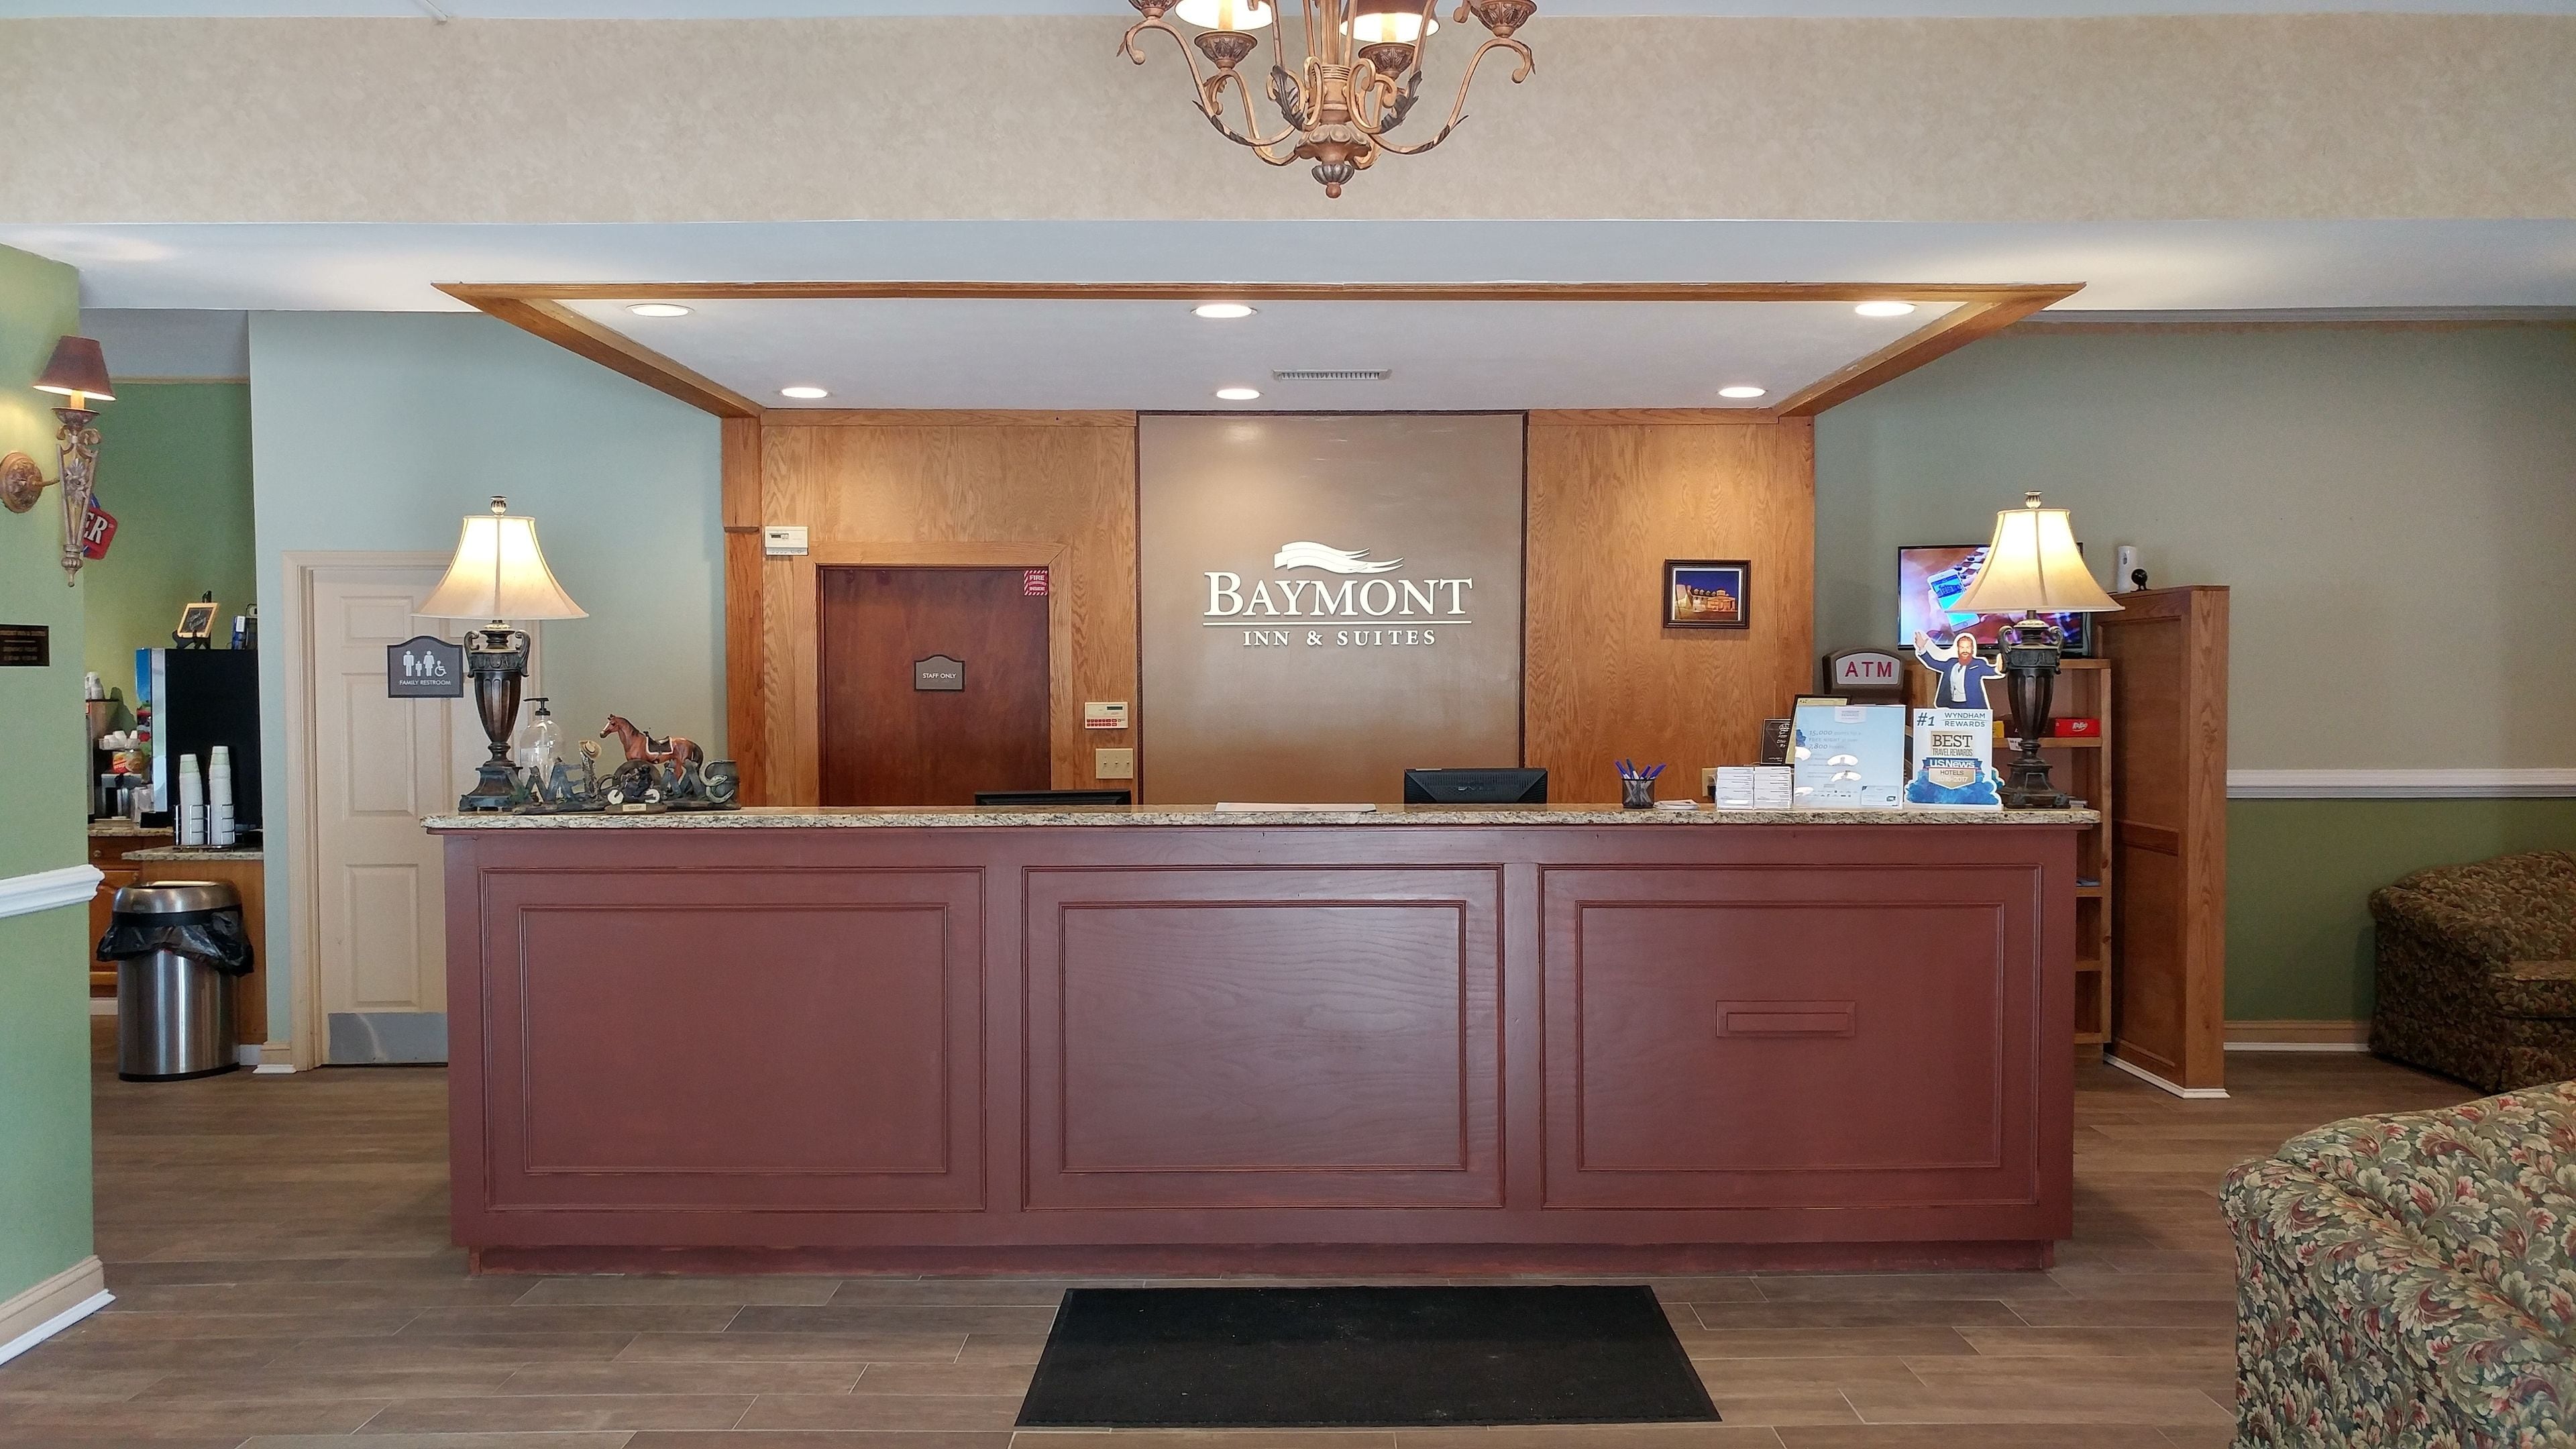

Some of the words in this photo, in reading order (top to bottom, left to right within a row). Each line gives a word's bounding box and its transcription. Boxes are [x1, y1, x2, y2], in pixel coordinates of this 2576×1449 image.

[1203, 572, 1473, 616] BAYMONT
[1242, 631, 1291, 647] INN
[1305, 631, 1324, 646] &
[1336, 629, 1436, 646] SUITES
[1845, 661, 1892, 678] ATM
[1917, 712, 1935, 727] #1
[1933, 735, 1973, 747] BEST
[1950, 749, 1973, 757] REWARDS
